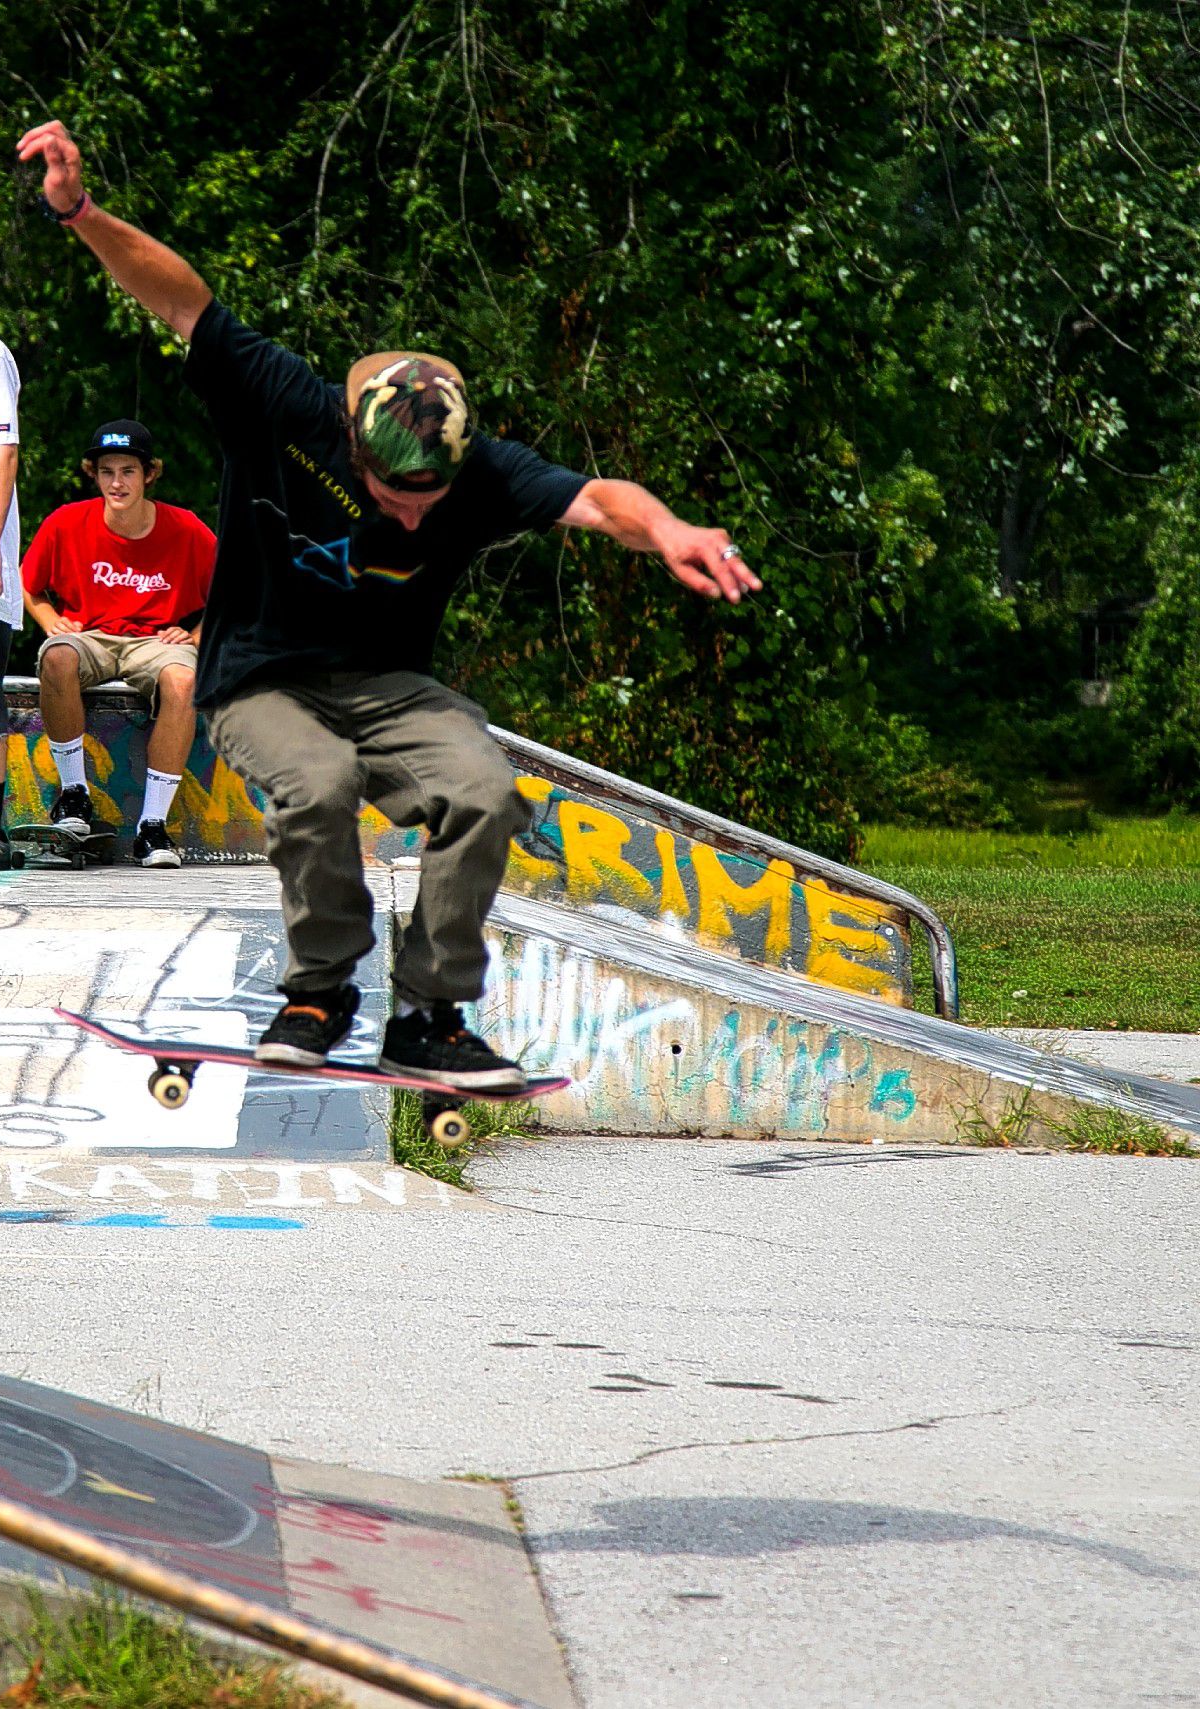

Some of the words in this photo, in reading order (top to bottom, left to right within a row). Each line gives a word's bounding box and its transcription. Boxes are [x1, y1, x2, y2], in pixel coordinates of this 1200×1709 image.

[285, 444, 320, 473] PINK
[318, 471, 361, 518] FLOYD
[91, 561, 172, 593] Redeyes
